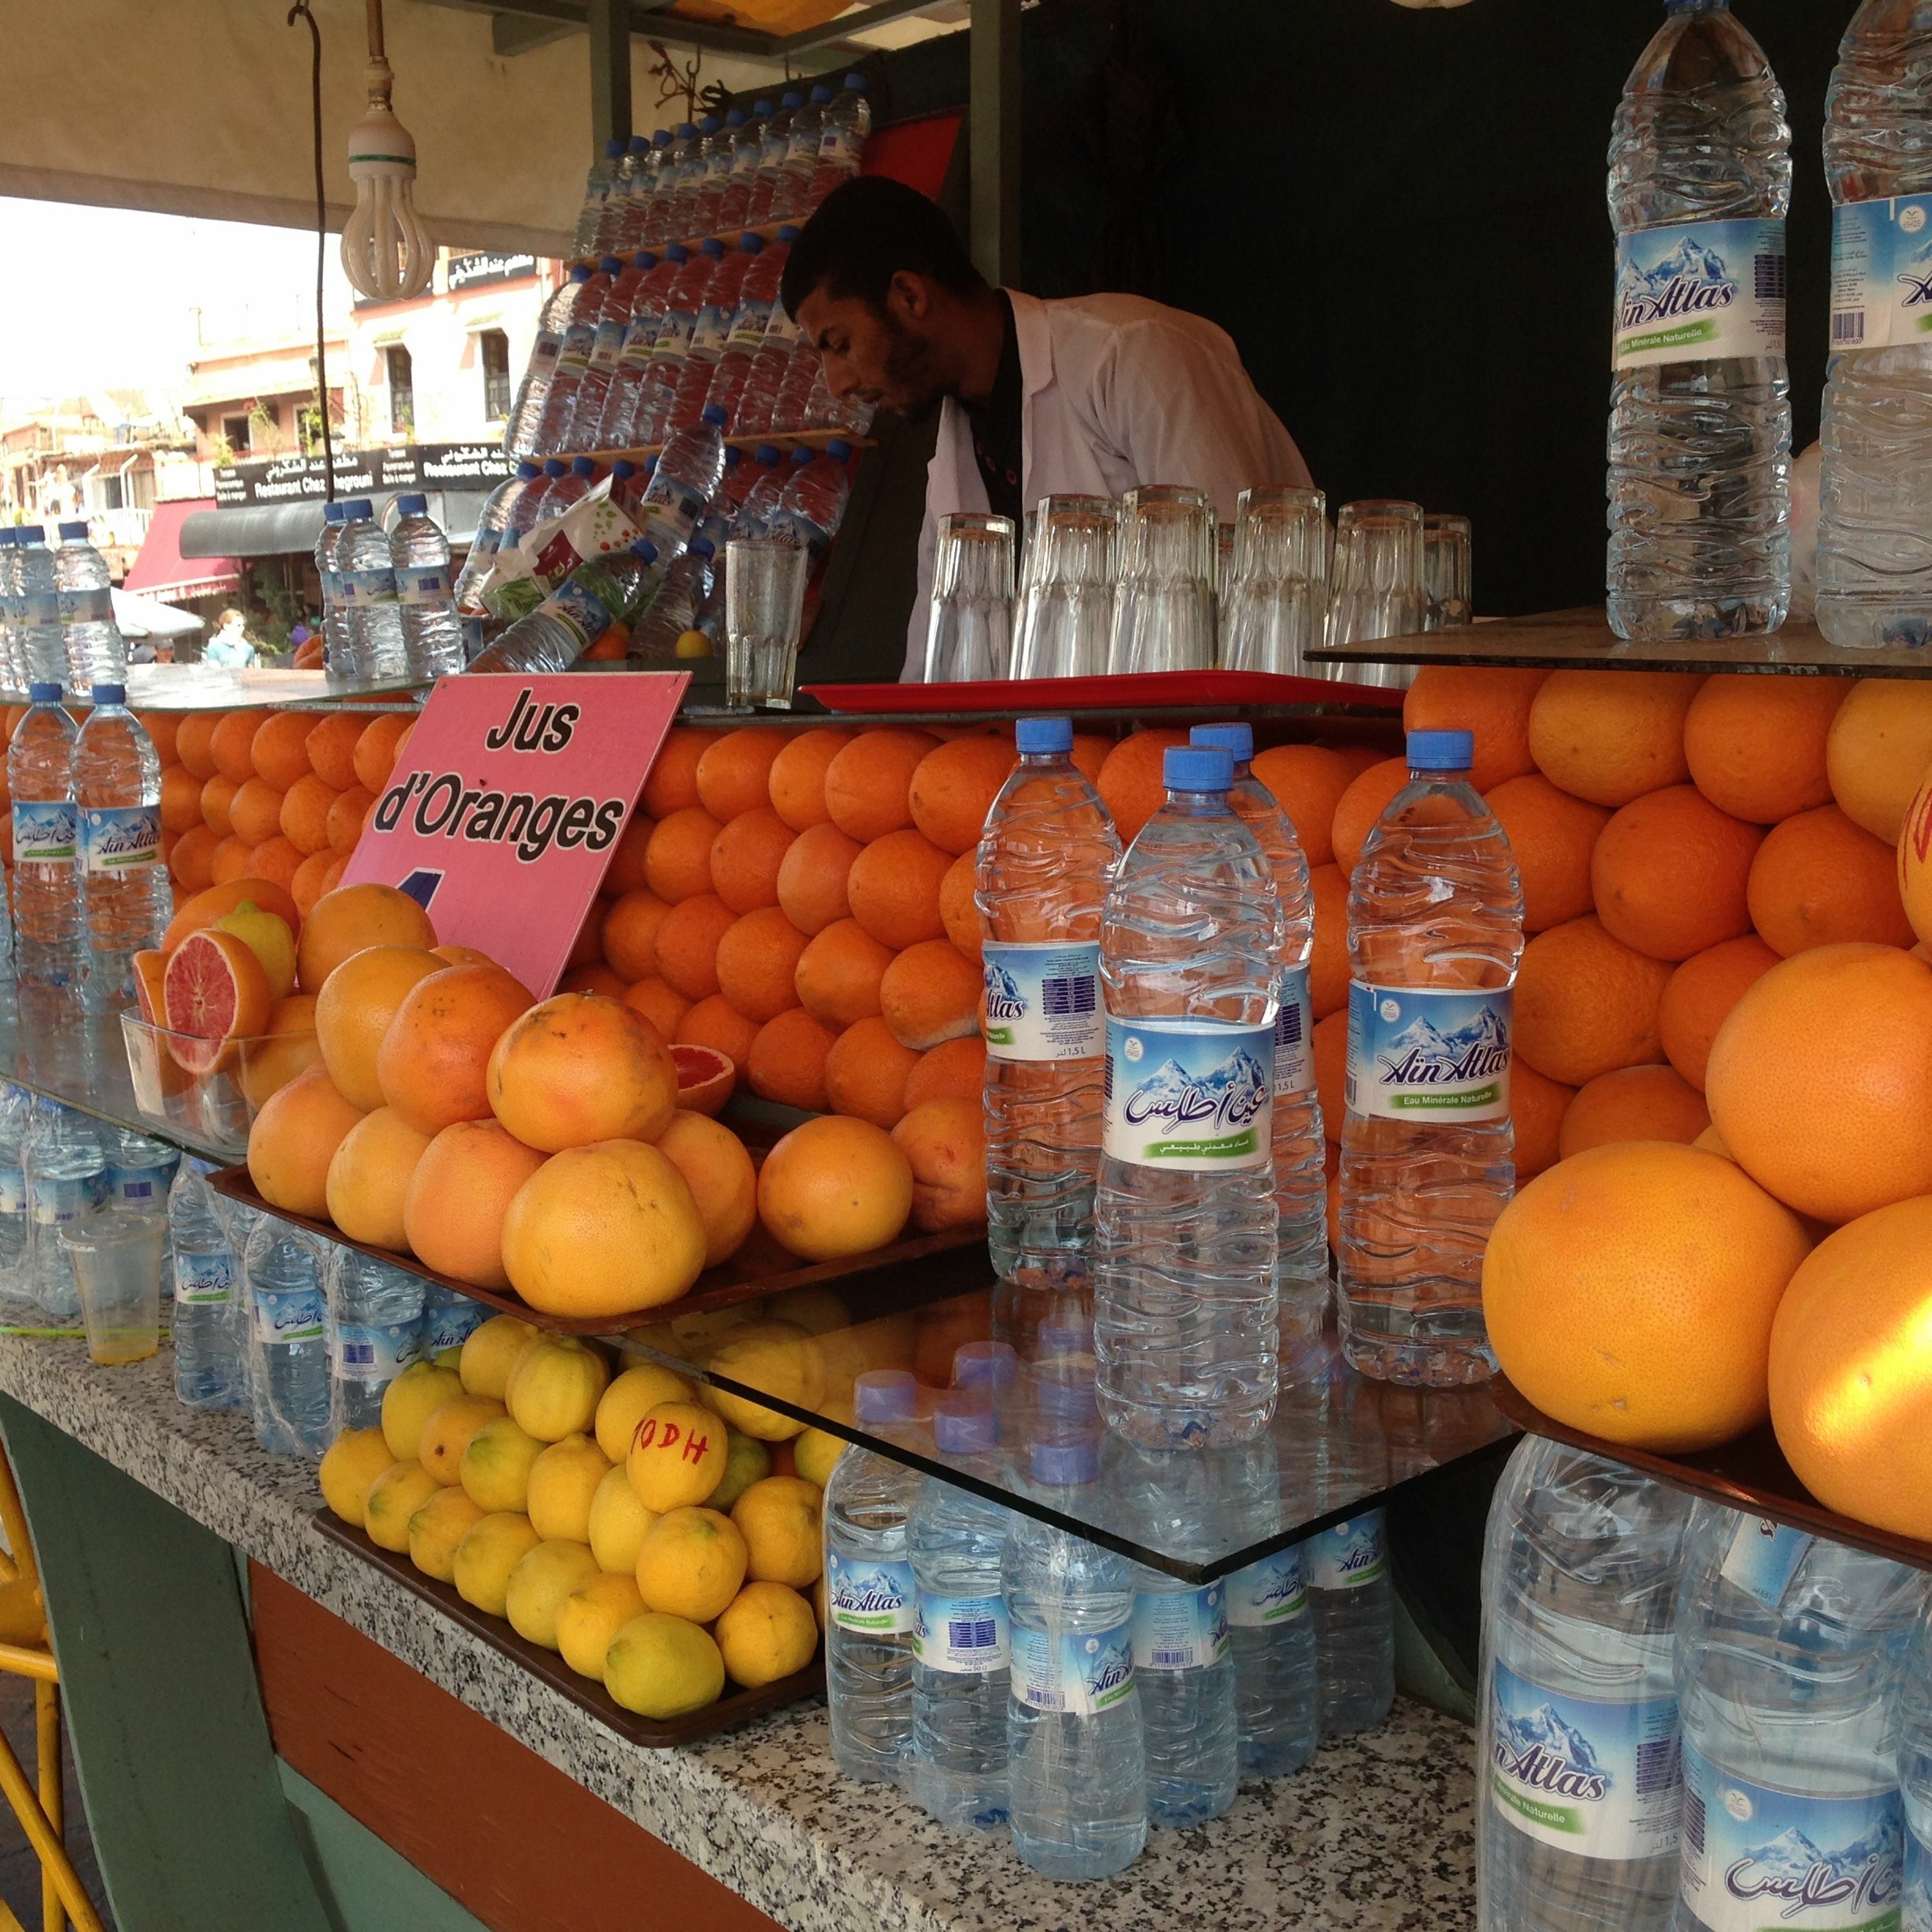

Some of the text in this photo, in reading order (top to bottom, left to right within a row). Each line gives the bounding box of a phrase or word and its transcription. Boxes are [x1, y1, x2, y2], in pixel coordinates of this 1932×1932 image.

[1642, 276, 1733, 320] Atlas
[1663, 329, 1702, 343] Naturelle
[255, 480, 303, 498] Restaurant
[303, 476, 326, 493] Chez
[334, 470, 374, 492] hegrouni
[485, 688, 581, 753] Jus
[374, 771, 625, 864] d'Oranges
[1378, 1041, 1510, 1084] Aïn Atlas
[1403, 1091, 1493, 1106] Eau Minérale Naturelle
[658, 1423, 709, 1464] DH
[851, 1589, 902, 1611] Atlas
[1504, 1743, 1605, 1801] Atlas
[1522, 1801, 1566, 1823] Naturelle
